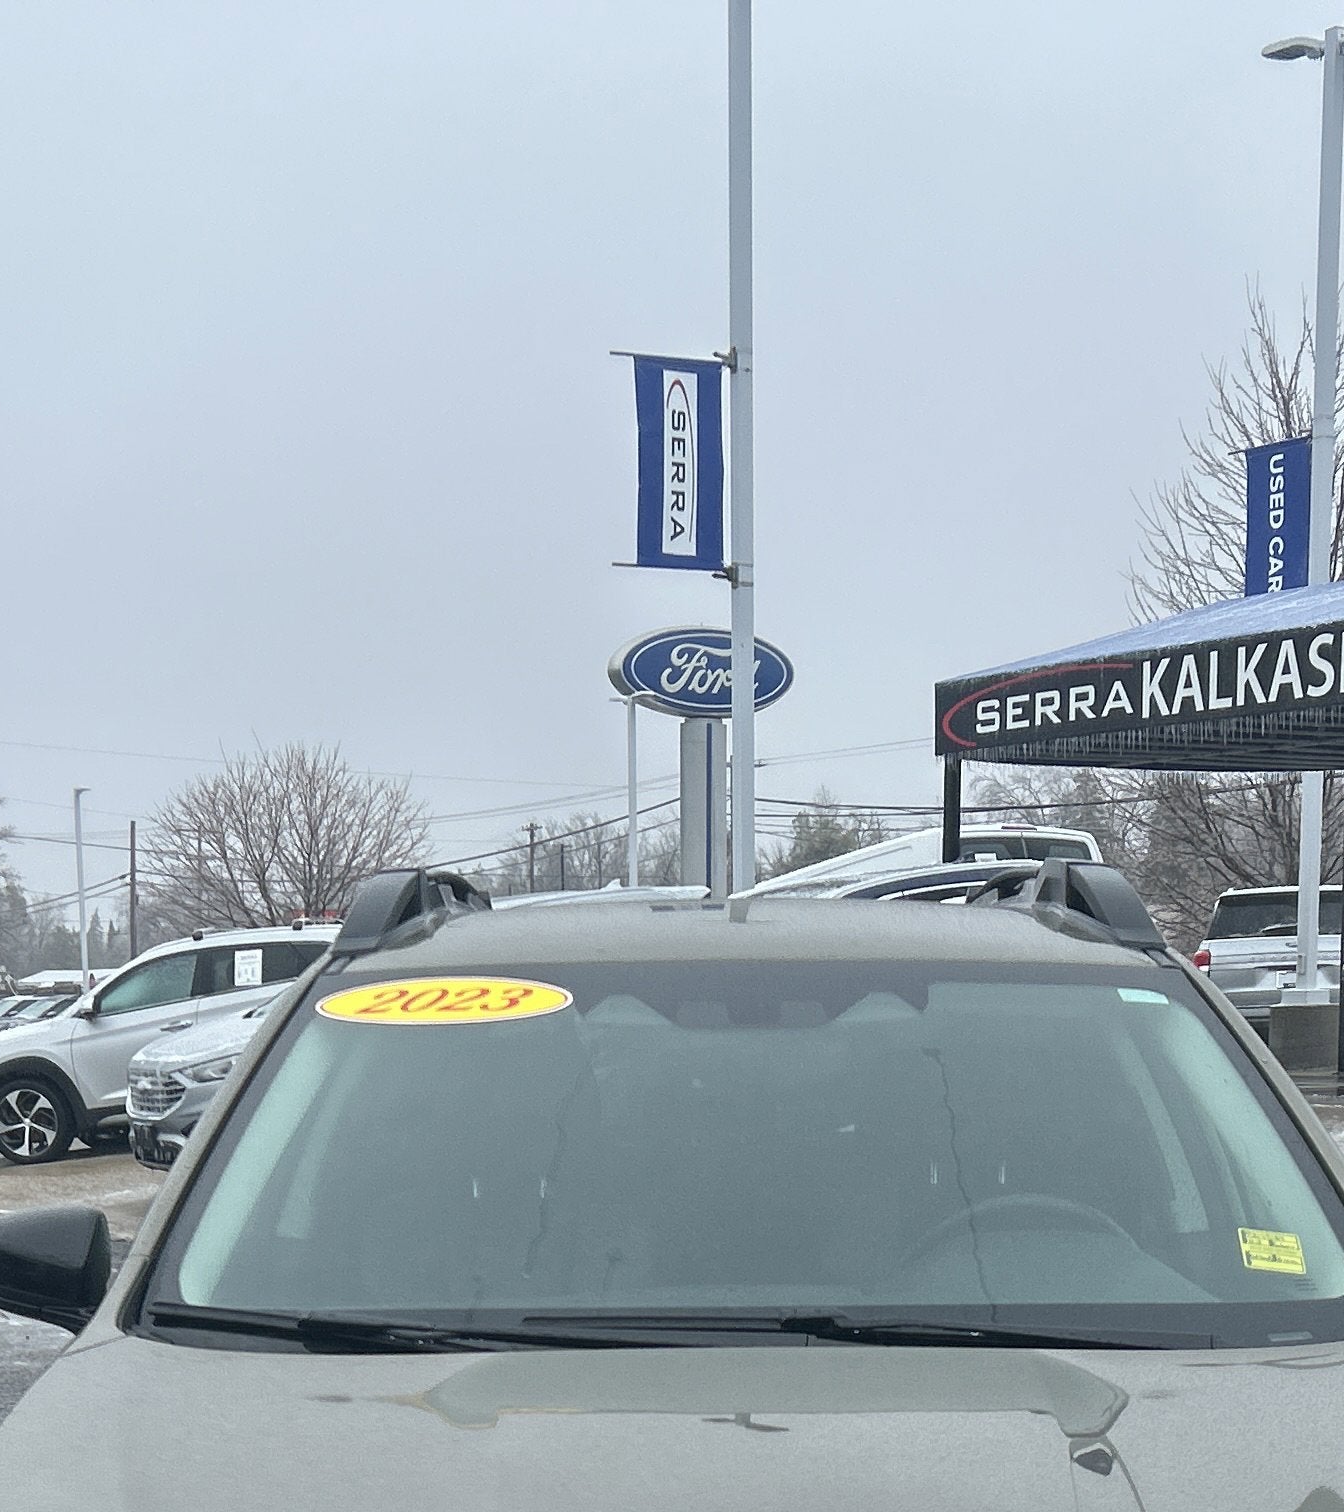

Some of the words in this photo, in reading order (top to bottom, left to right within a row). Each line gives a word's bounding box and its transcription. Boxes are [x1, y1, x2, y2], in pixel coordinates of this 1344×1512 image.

[670, 408, 686, 542] SERRA
[1269, 453, 1284, 529] USED
[975, 679, 1133, 734] SERRA
[354, 987, 534, 1015] 2023
